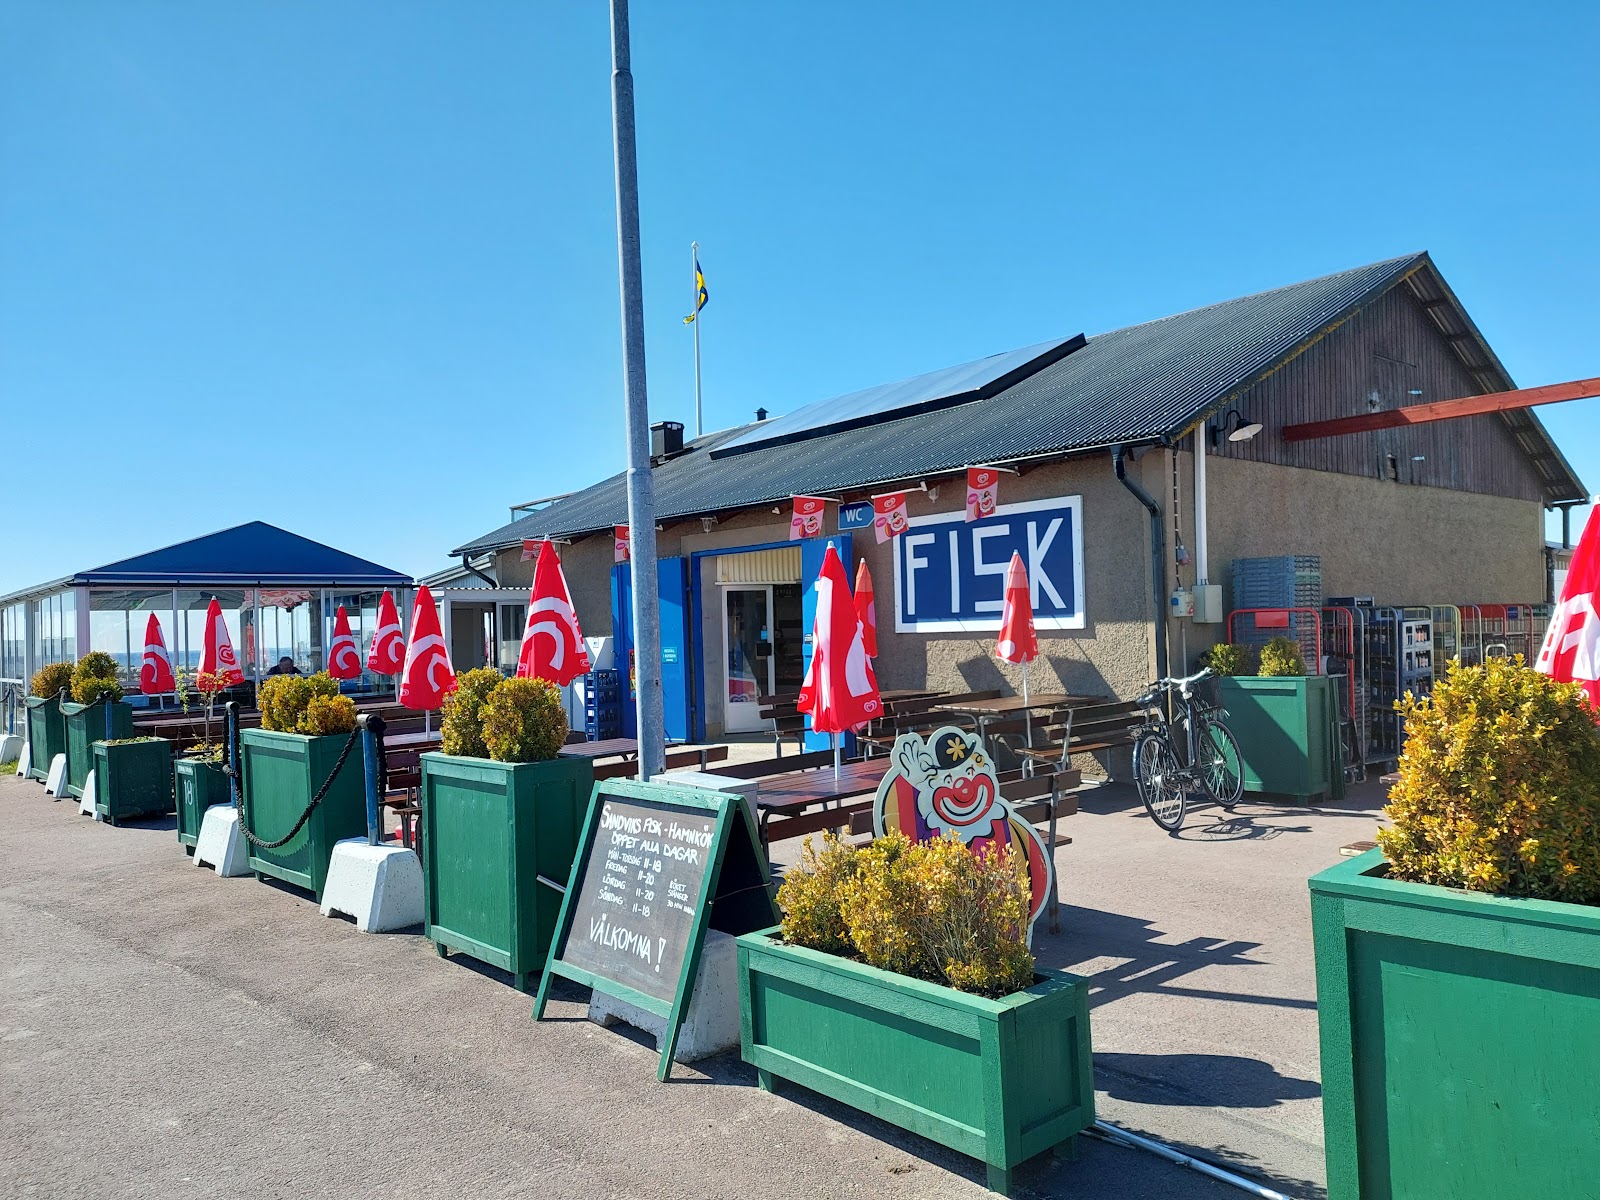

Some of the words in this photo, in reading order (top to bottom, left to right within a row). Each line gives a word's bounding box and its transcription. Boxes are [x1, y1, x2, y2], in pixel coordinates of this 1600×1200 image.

[845, 508, 863, 522] WC
[905, 517, 1067, 616] FISK
[184, 779, 193, 806] 18
[643, 817, 662, 837] FISK
[611, 831, 640, 849] ÖPPET
[663, 843, 698, 865] DAGAR
[605, 860, 628, 875] FREDAG
[635, 888, 655, 901] 11-20
